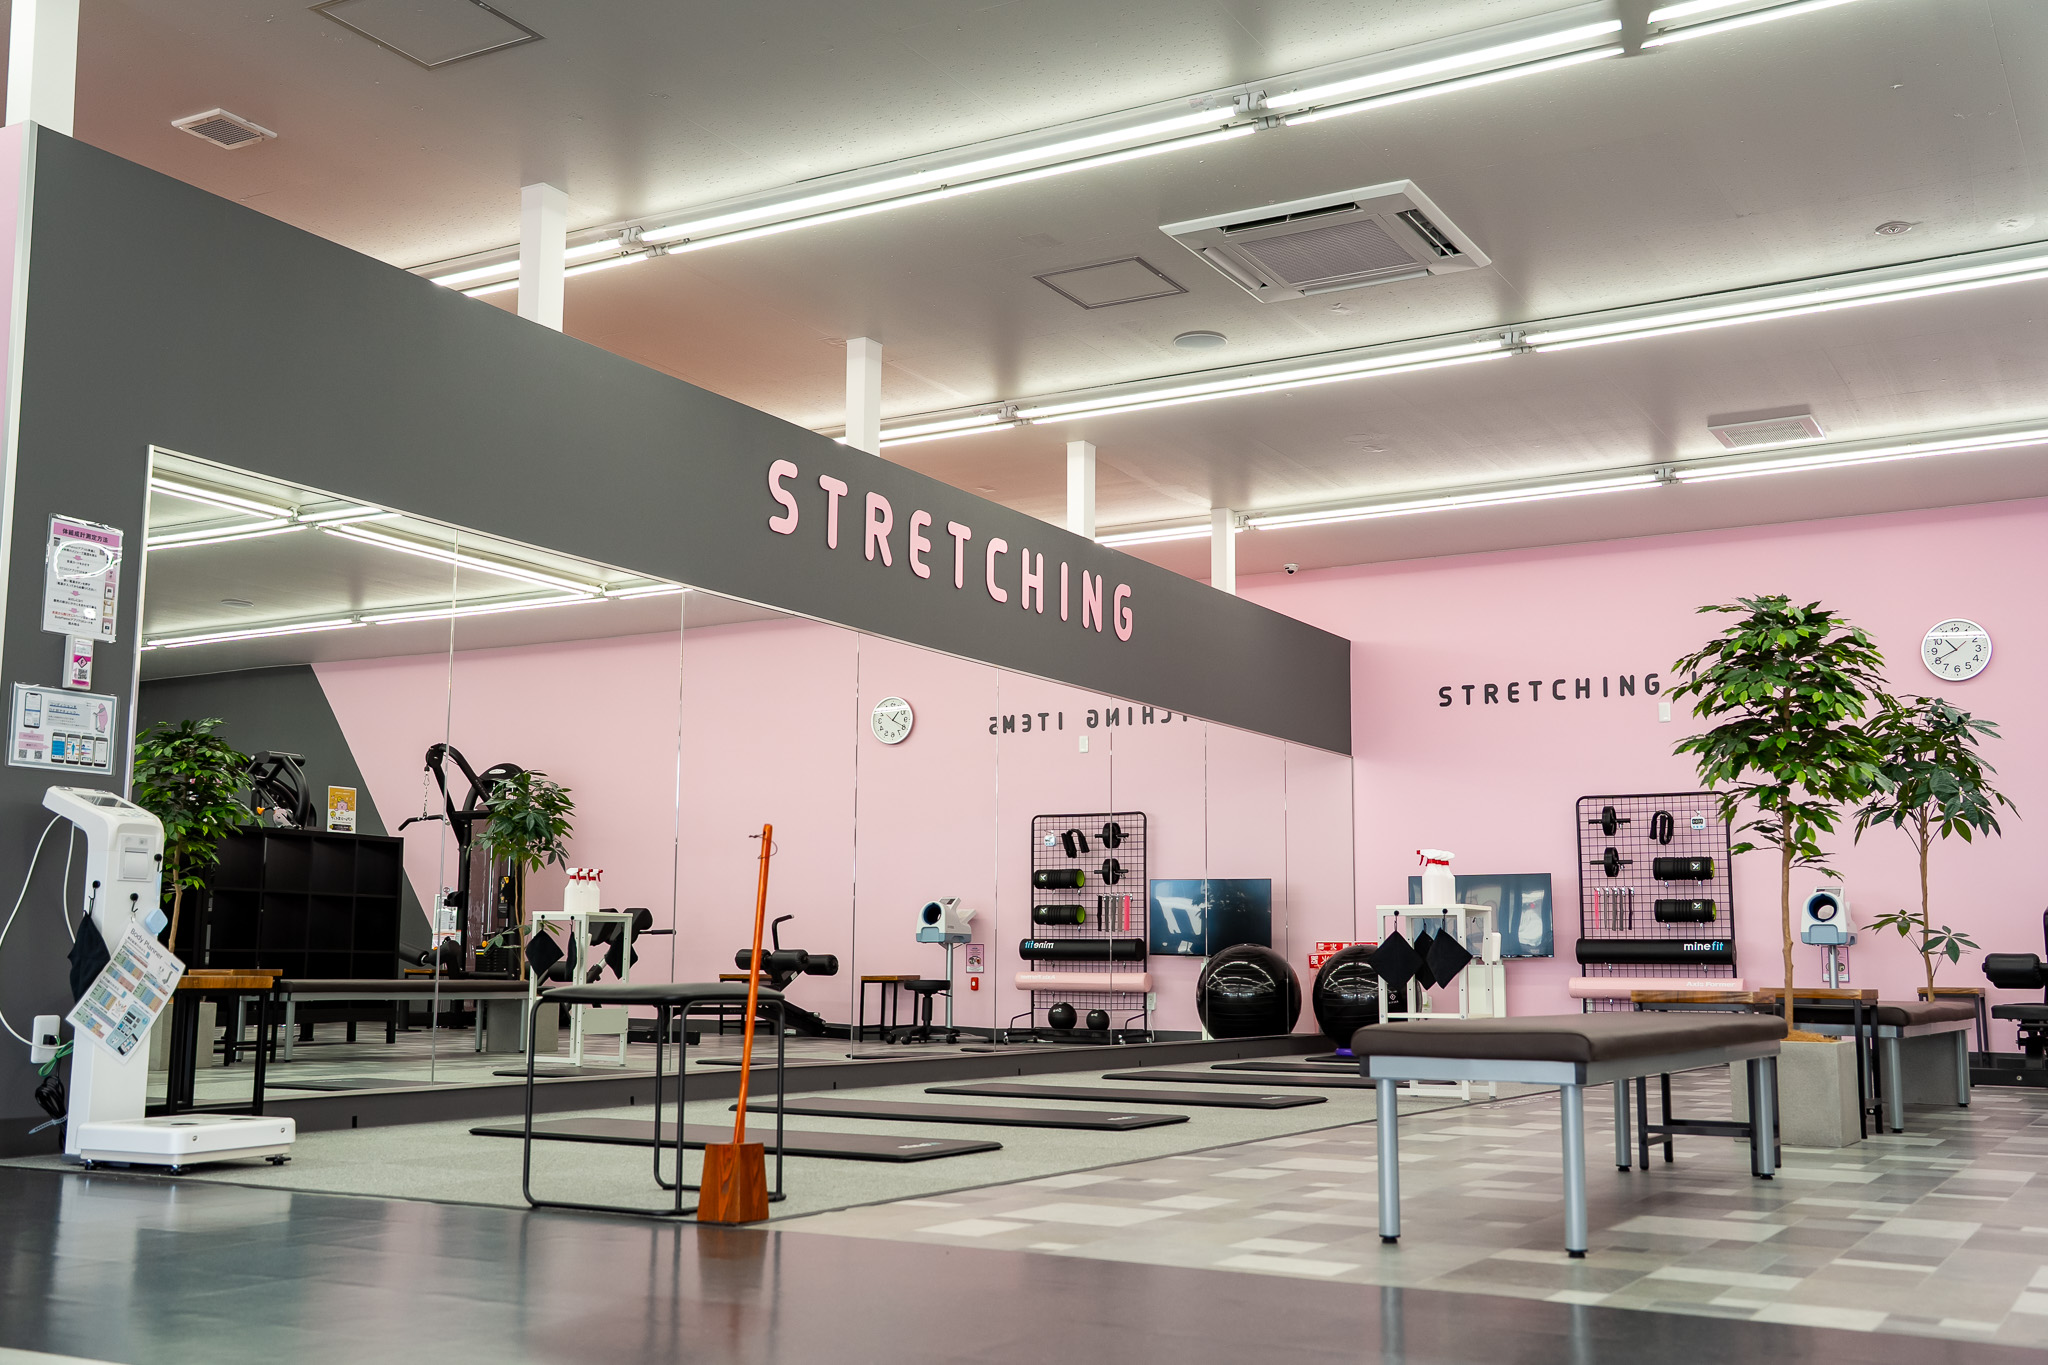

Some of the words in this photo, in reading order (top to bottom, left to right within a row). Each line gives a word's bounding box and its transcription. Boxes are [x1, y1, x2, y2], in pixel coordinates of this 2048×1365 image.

[768, 459, 1133, 641] STRETCHING
[1931, 648, 1938, 656] 9
[1975, 644, 1982, 652] 3
[1943, 663, 1950, 671] 7
[1965, 662, 1972, 670] 5
[1439, 672, 1661, 708] STRETCHING
[130, 928, 144, 944] Body
[144, 940, 163, 960] Planner
[1683, 941, 1724, 951] minefit
